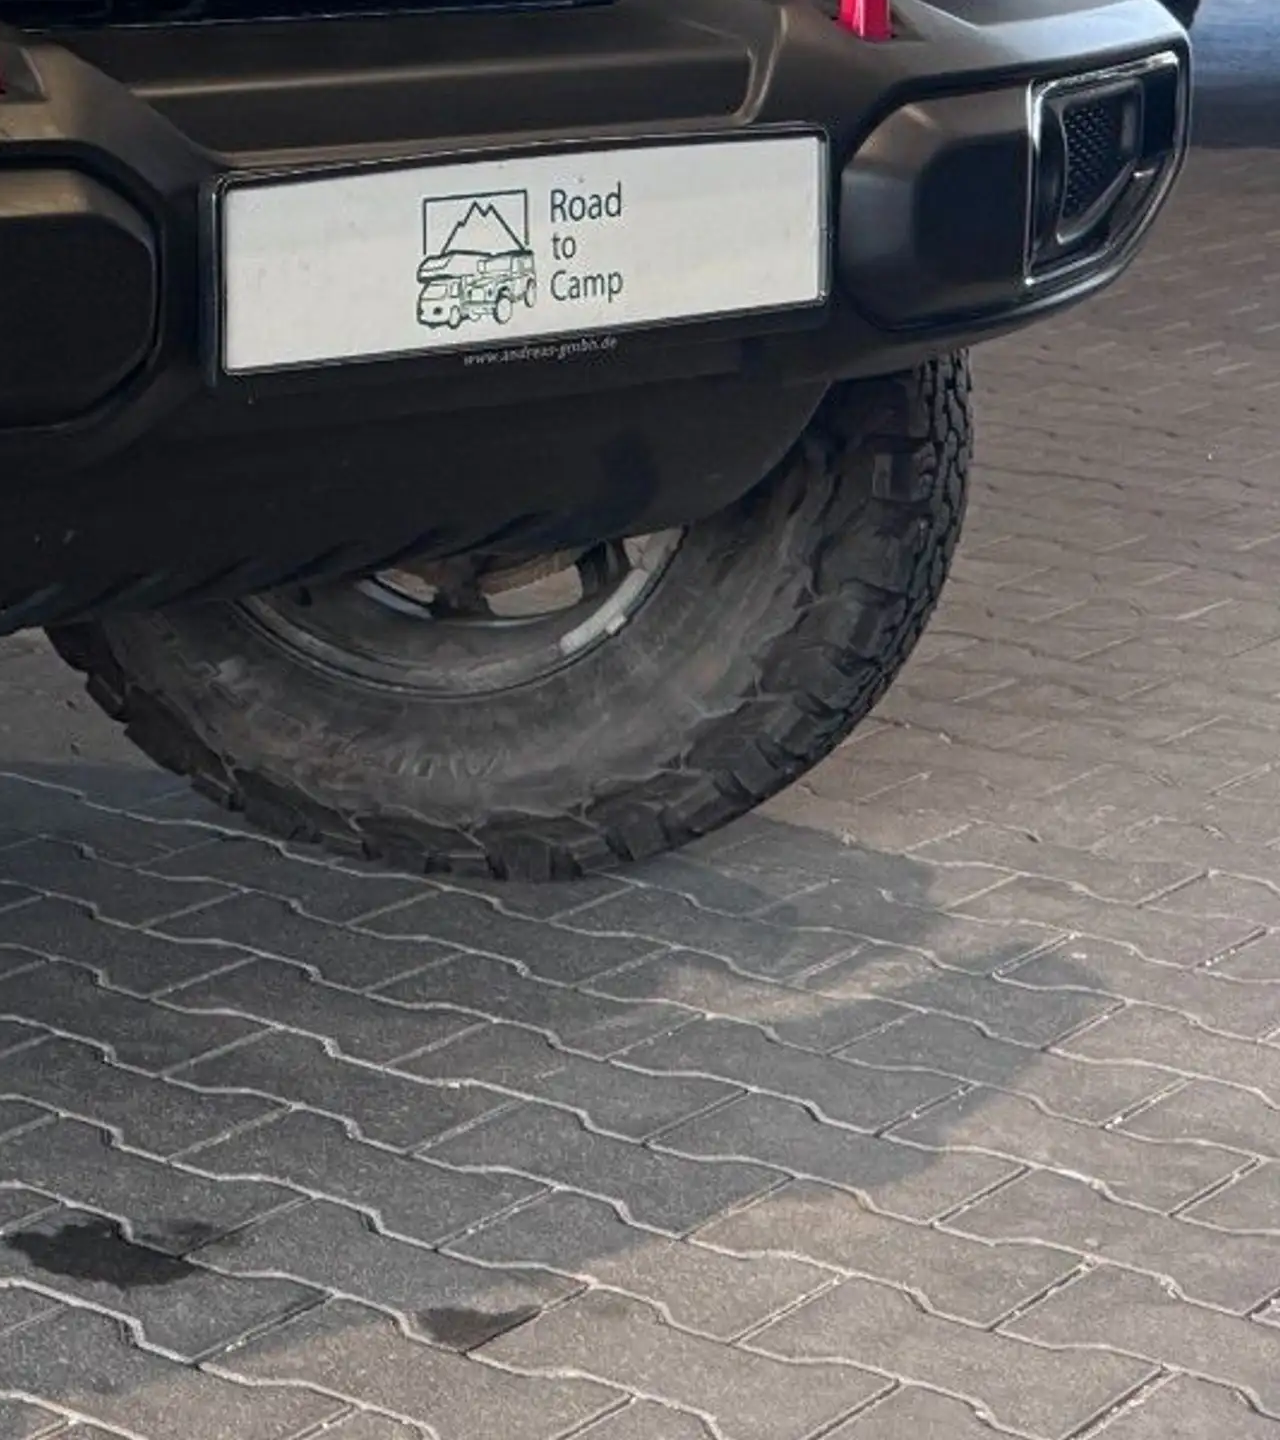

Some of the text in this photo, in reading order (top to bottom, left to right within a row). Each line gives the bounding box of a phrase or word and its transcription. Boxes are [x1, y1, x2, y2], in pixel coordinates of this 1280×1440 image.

[549, 181, 622, 223] Road
[551, 233, 577, 260] to
[549, 268, 623, 304] Camp
